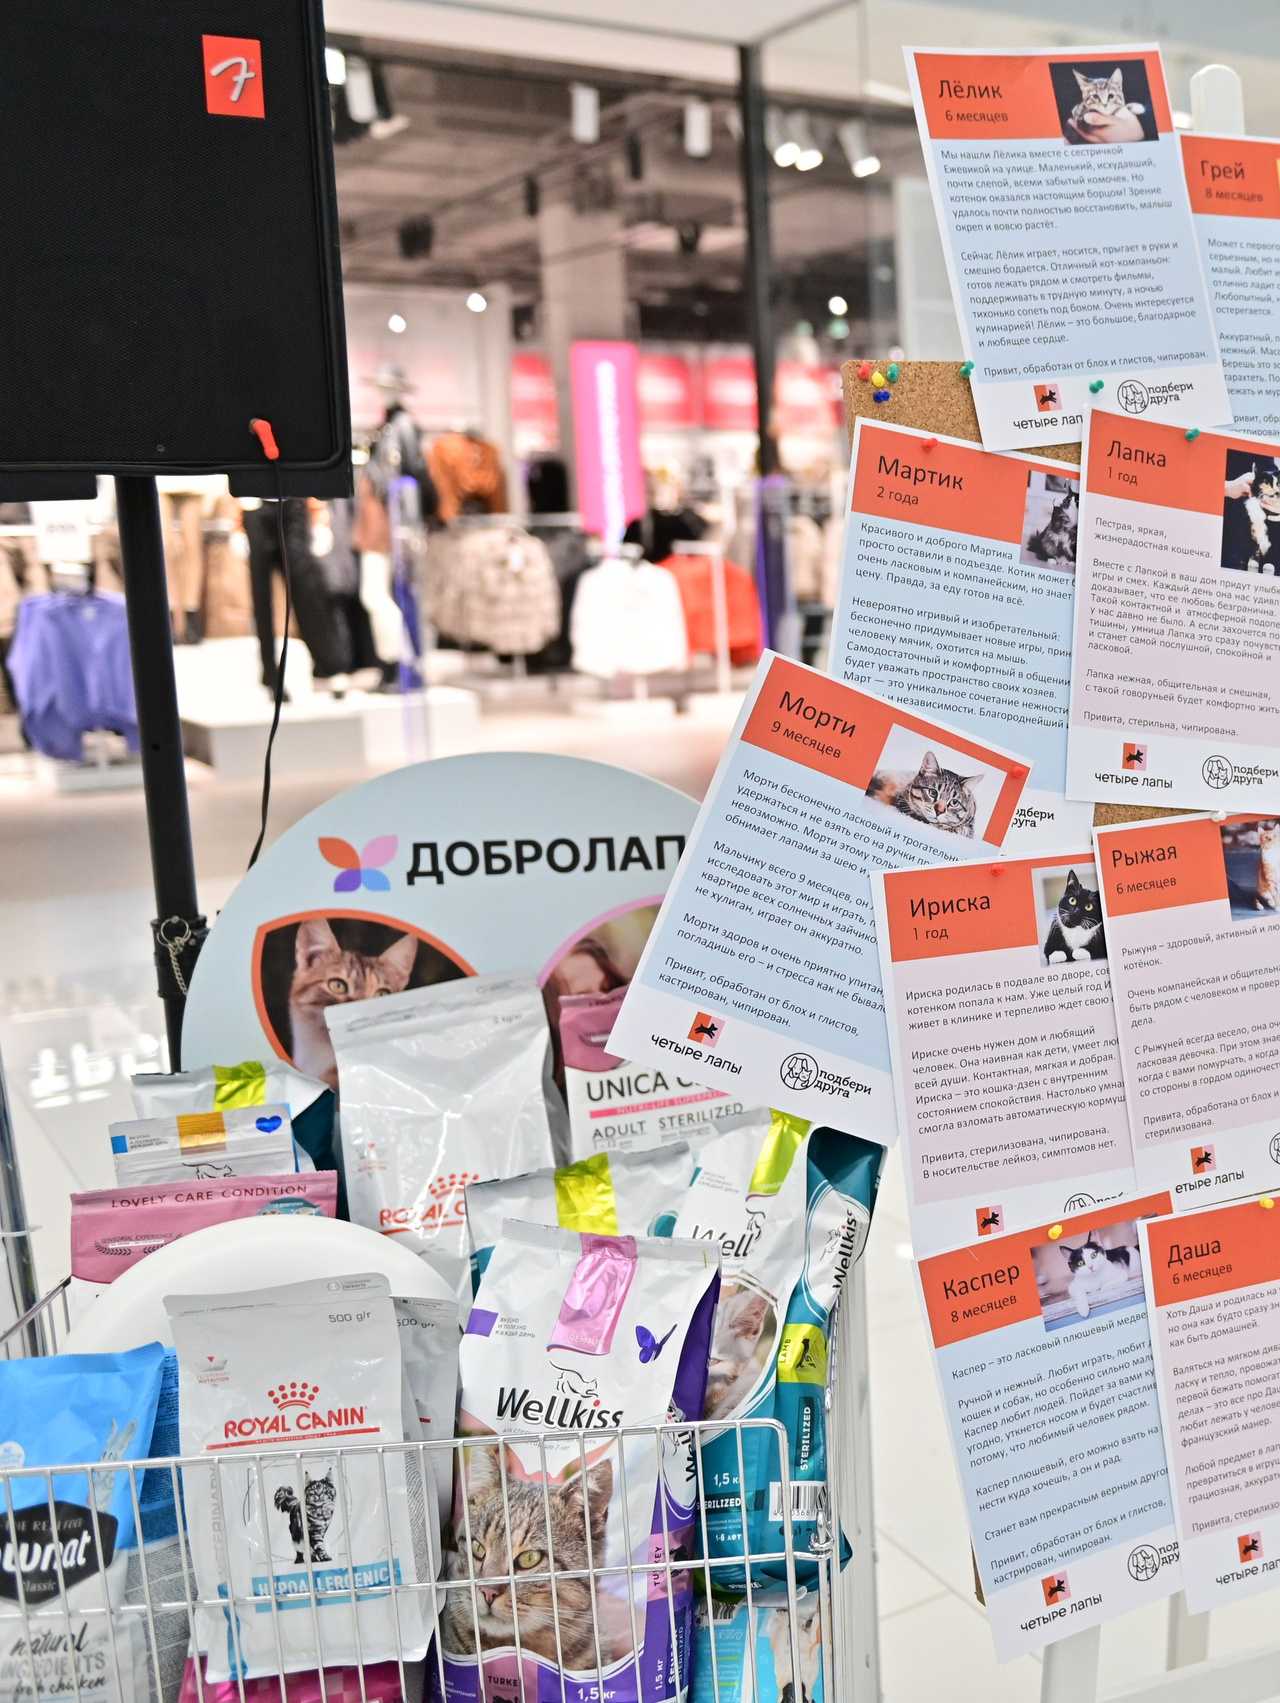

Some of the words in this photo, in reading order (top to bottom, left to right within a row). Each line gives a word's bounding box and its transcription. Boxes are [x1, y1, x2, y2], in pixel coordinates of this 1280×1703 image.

[939, 79, 1002, 98] Лёлик
[945, 110, 953, 121] 6
[956, 112, 1008, 123] месяцев
[941, 150, 958, 159] Мы
[993, 150, 1026, 159] Лёлика
[1029, 150, 1061, 158] вместе
[1070, 146, 1123, 157] сестричкой
[1200, 160, 1244, 181] Грей
[1205, 187, 1212, 198] 8
[1215, 190, 1263, 202] месяцев
[1148, 382, 1193, 394] подбери
[1151, 394, 1180, 404] друга
[1013, 417, 1058, 429] четыре
[1062, 414, 1082, 425] лап
[1107, 440, 1166, 467] Лапка
[878, 455, 963, 490] Мартик
[1108, 466, 1112, 478] 1
[1118, 472, 1137, 486] год
[877, 486, 884, 498] 2
[889, 491, 918, 506] года
[861, 522, 914, 540] Красивого
[925, 537, 967, 551] доброго
[970, 543, 1012, 560] Мартика
[779, 691, 856, 737] Морти
[1083, 711, 1125, 725] Привита,
[1128, 718, 1178, 731] стерильна,
[1181, 724, 1238, 736] чипирована.
[771, 721, 781, 732] 9
[782, 728, 841, 758] месяцев
[1094, 773, 1138, 785] четыре
[1141, 777, 1172, 788] лапы
[1233, 775, 1263, 785] друга
[1234, 766, 1278, 778] подбери
[1011, 817, 1036, 828] руга
[406, 835, 686, 885] ДОБРОЛАП
[1112, 846, 1177, 867] Рыжая
[1116, 882, 1123, 894] 6
[1127, 877, 1176, 892] месяцев
[910, 896, 990, 920] Ириска
[913, 927, 918, 940] 1
[925, 928, 948, 940] год
[658, 973, 728, 1005] кастрирован,
[732, 999, 790, 1027] чипирован.
[665, 956, 706, 980] Привит,
[709, 975, 766, 1001] обработан
[768, 996, 780, 1005] от
[782, 999, 807, 1016] блох
[808, 1011, 816, 1019] и
[817, 1015, 858, 1036] глистов,
[651, 1034, 702, 1060] четыре
[704, 1054, 742, 1074] лапы
[587, 1072, 669, 1101] UNICA
[815, 1080, 849, 1098] друга
[819, 1070, 871, 1094] подбери
[1143, 1111, 1183, 1125] Привита,
[1185, 1099, 1238, 1116] обработана
[1239, 1096, 1249, 1104] от
[1251, 1092, 1272, 1102] блох
[592, 1120, 647, 1139] ADULT
[921, 1150, 967, 1164] Привита,
[969, 1137, 1046, 1156] стерилизована,
[1048, 1127, 1109, 1142] чипирована.
[1175, 1178, 1211, 1193] етыре
[1214, 1170, 1244, 1185] лапы
[111, 1195, 167, 1208] LOVELY
[175, 1190, 213, 1203] CARE
[222, 1185, 307, 1198] CONDITION
[101, 1235, 134, 1244] SENSORIAL
[135, 1233, 173, 1242] EXPERIENCE
[1167, 1240, 1221, 1268] Даша
[943, 1265, 1019, 1299] Каспер
[1172, 1273, 1180, 1284] 6
[1183, 1264, 1232, 1282] месяцев
[328, 1313, 352, 1323] 500
[950, 1310, 959, 1322] 8
[962, 1295, 1016, 1319] месяцев
[779, 1338, 791, 1364] LAMB
[496, 1387, 624, 1429] Wellkiss
[224, 1414, 291, 1439] ROYAL
[296, 1406, 365, 1430] CANIN
[800, 1406, 811, 1470] STERILIZED
[714, 1473, 730, 1487] 1,5
[733, 1476, 740, 1485] к
[1192, 1515, 1232, 1532] Привита,
[1161, 1552, 1179, 1566] дру
[1215, 1566, 1258, 1585] четыре
[1020, 1607, 1066, 1631] четыре
[1070, 1594, 1102, 1613] лапы
[578, 1687, 599, 1702] 1,5
[603, 1691, 616, 1700] кг
